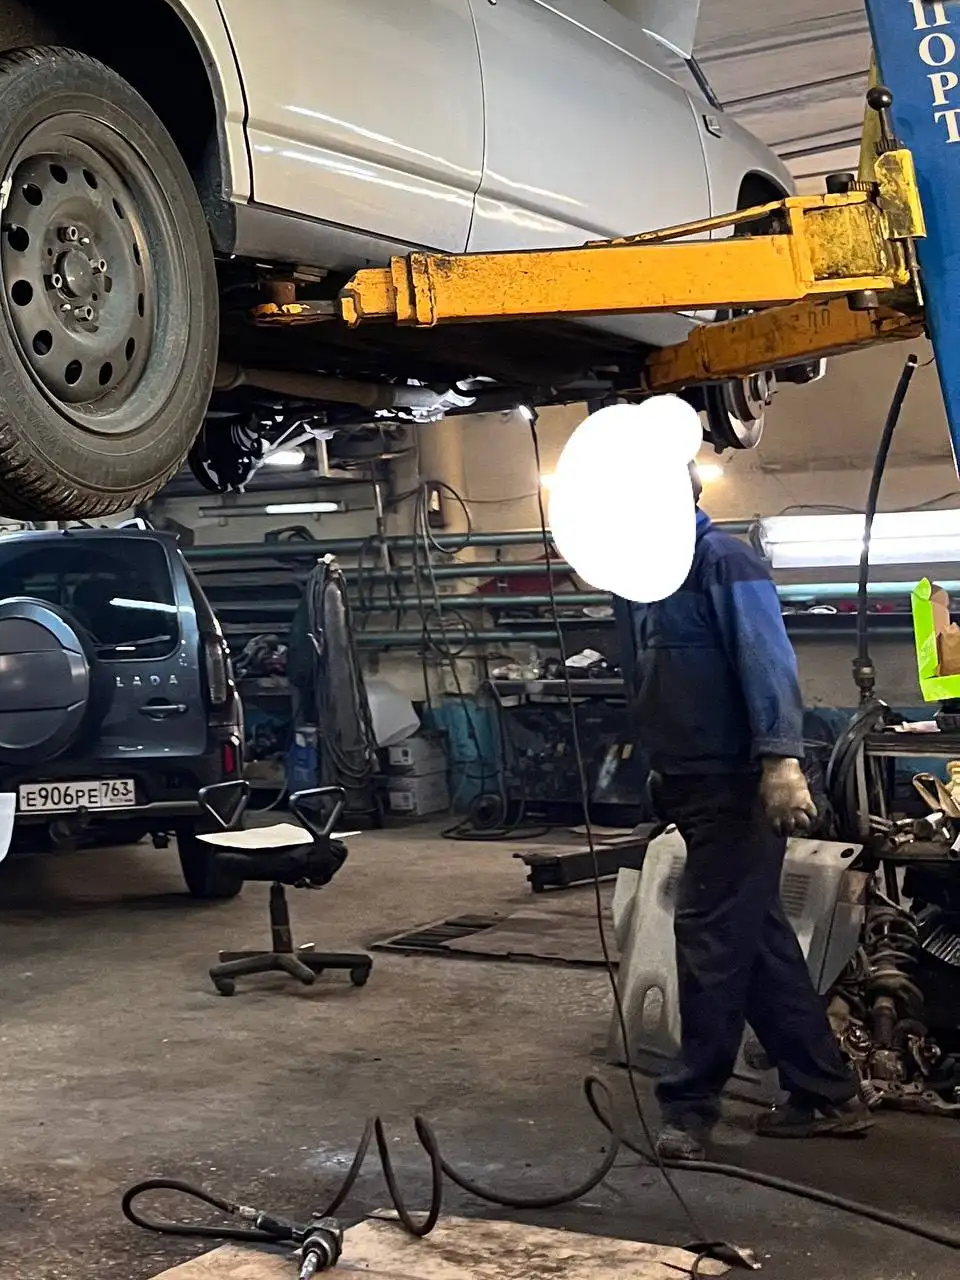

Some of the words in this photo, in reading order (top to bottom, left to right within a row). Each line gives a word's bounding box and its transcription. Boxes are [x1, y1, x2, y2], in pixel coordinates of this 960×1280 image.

[116, 674, 178, 687] LADA
[26, 786, 98, 807] Е906РЕ
[101, 781, 130, 798] 763
